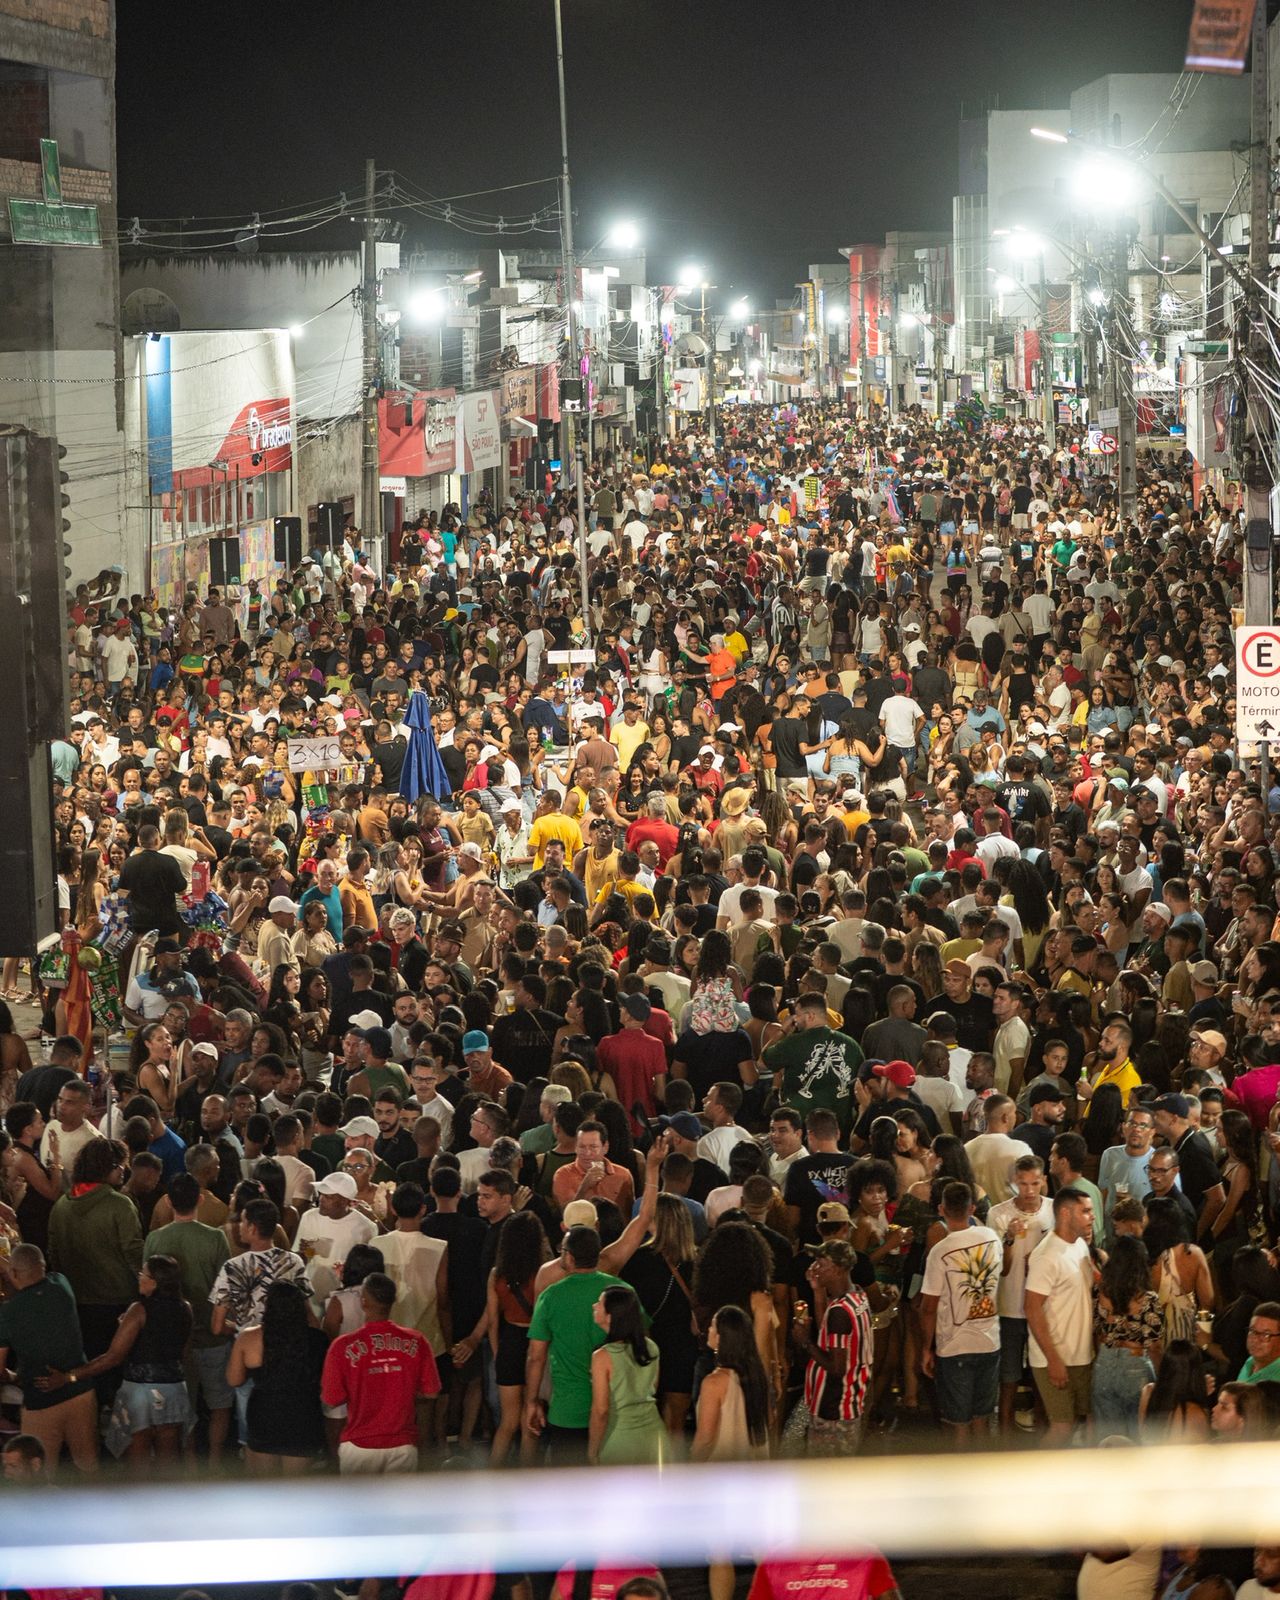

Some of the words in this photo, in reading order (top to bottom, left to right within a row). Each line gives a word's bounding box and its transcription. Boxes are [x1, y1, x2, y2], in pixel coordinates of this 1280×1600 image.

[261, 420, 292, 448] bradesco
[1256, 643, 1273, 667] E
[786, 1578, 849, 1591] CORDEIROS
